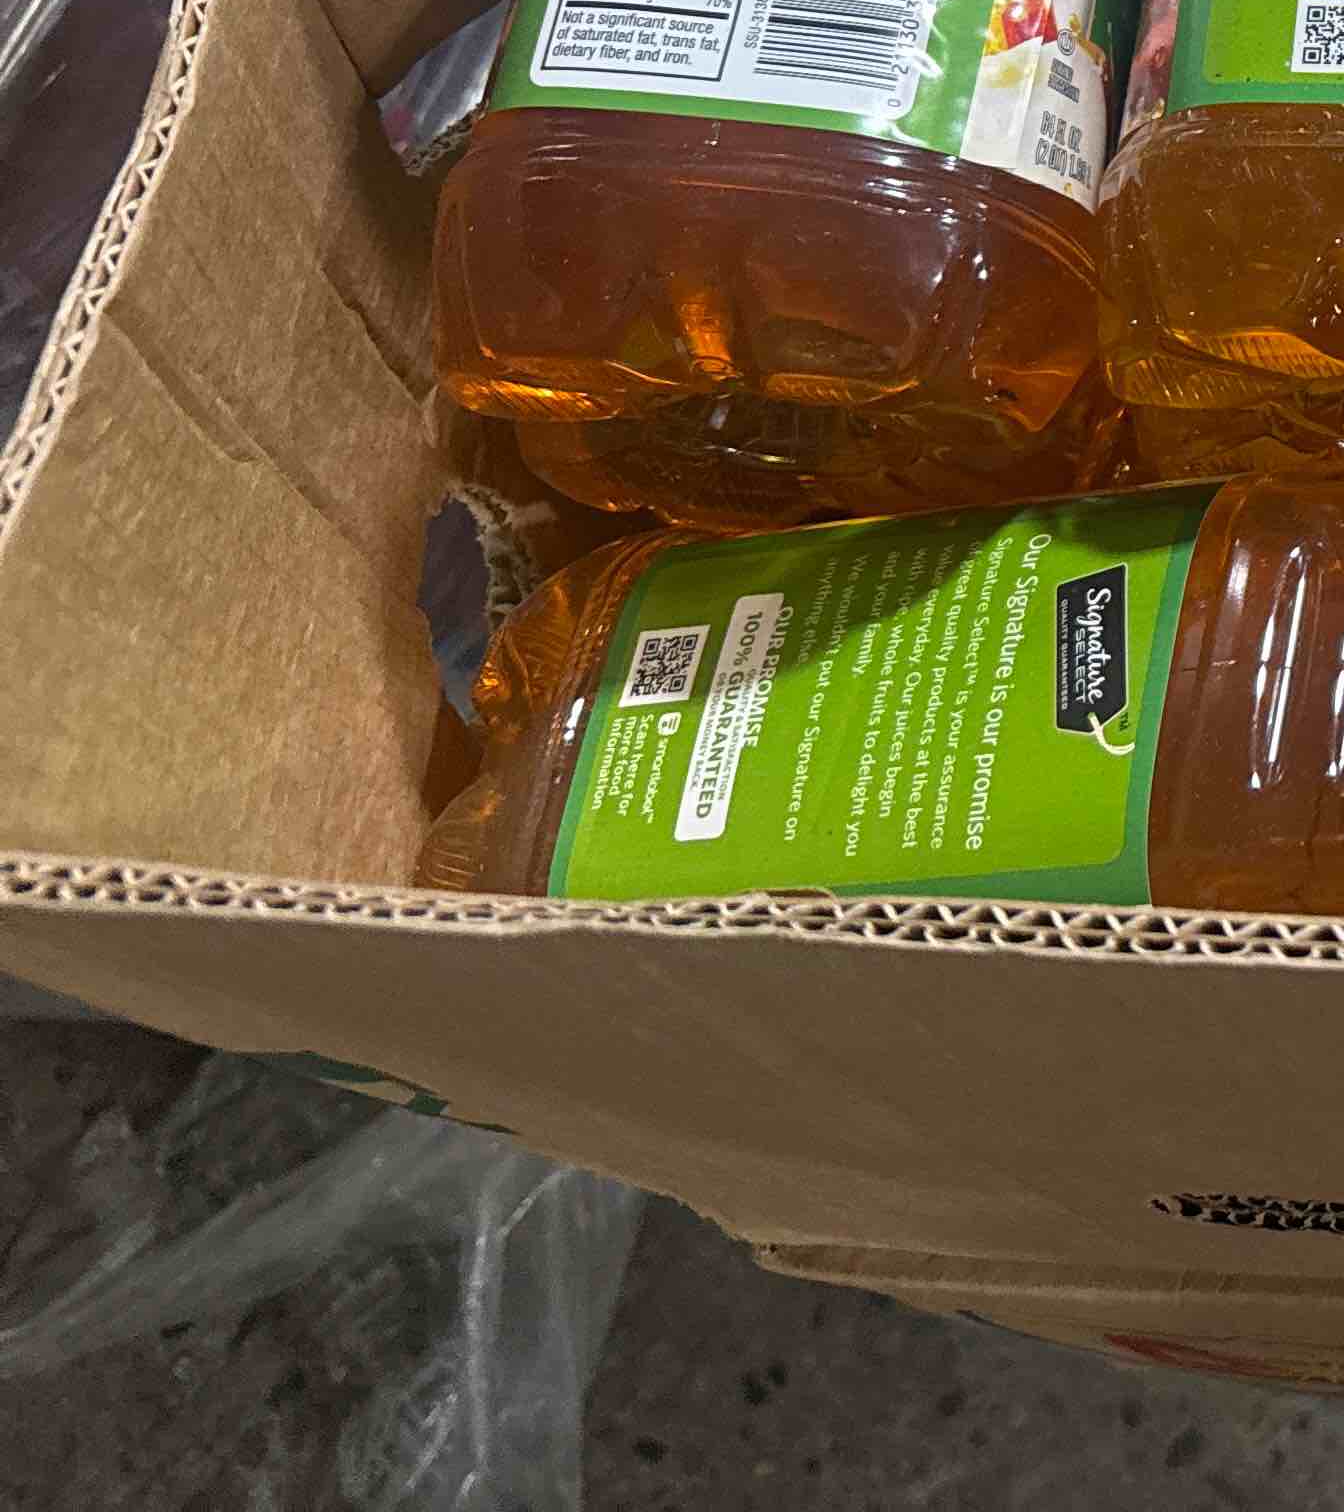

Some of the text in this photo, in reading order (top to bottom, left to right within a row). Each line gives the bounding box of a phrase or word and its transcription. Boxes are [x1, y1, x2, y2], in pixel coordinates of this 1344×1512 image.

[552, 44, 692, 65] dietary fiber, and iron.
[557, 27, 720, 52] of saturated fat, trans fat,
[562, 11, 715, 34] Not a significant source
[1074, 628, 1086, 703] SELECT
[1076, 587, 1111, 705] Signature
[696, 612, 762, 818] 100% GUARANTEED
[966, 534, 1052, 850] Our Signature is our promise
